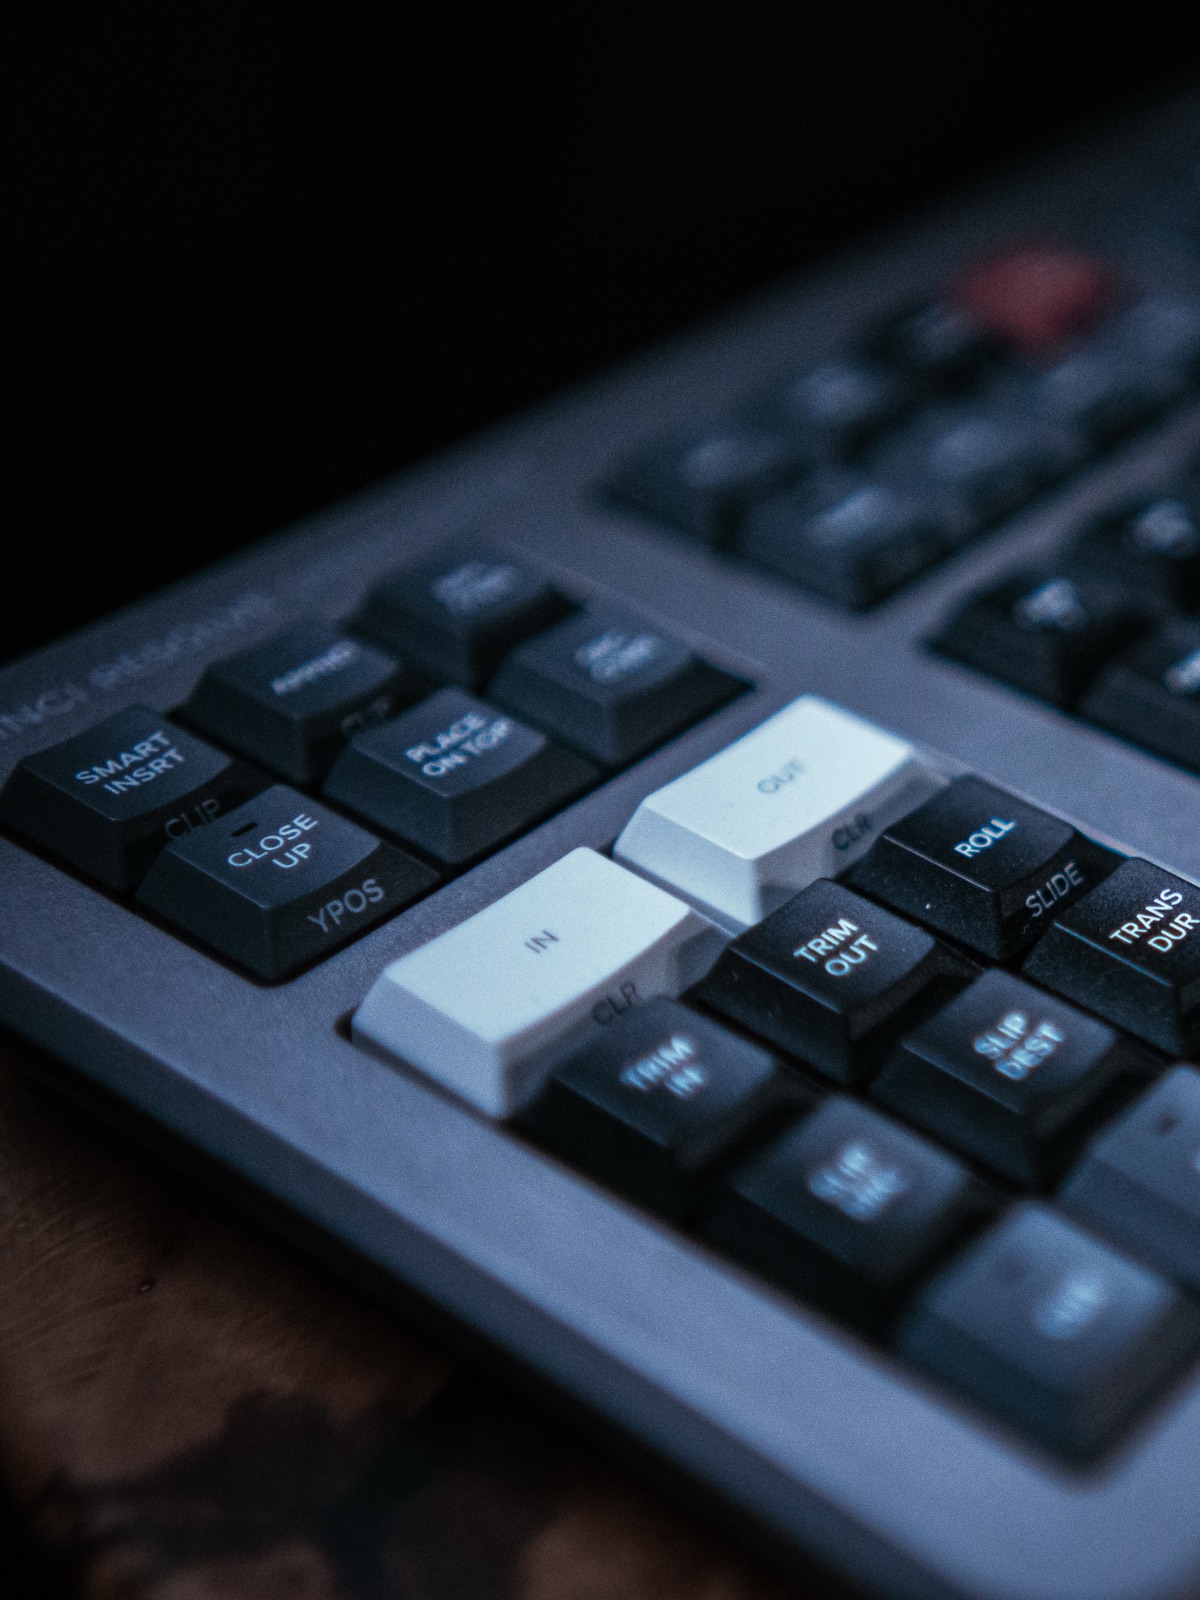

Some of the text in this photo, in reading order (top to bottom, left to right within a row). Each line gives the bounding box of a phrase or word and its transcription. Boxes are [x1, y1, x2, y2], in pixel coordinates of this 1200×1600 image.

[74, 729, 170, 785] SMART
[103, 747, 185, 795] INSRT
[756, 758, 806, 795] OUT
[227, 814, 319, 867] CLOSE
[831, 812, 873, 851] CLR
[953, 816, 1018, 859] ROLL
[271, 842, 312, 869] UP
[306, 878, 384, 933] YPOS
[1024, 861, 1084, 918] SLIDE
[1108, 888, 1183, 945] TRANS
[1148, 912, 1200, 953] DUR
[523, 929, 560, 954] IN
[793, 917, 859, 964] TRIM
[824, 934, 880, 977] OUT
[589, 981, 642, 1027] CLR
